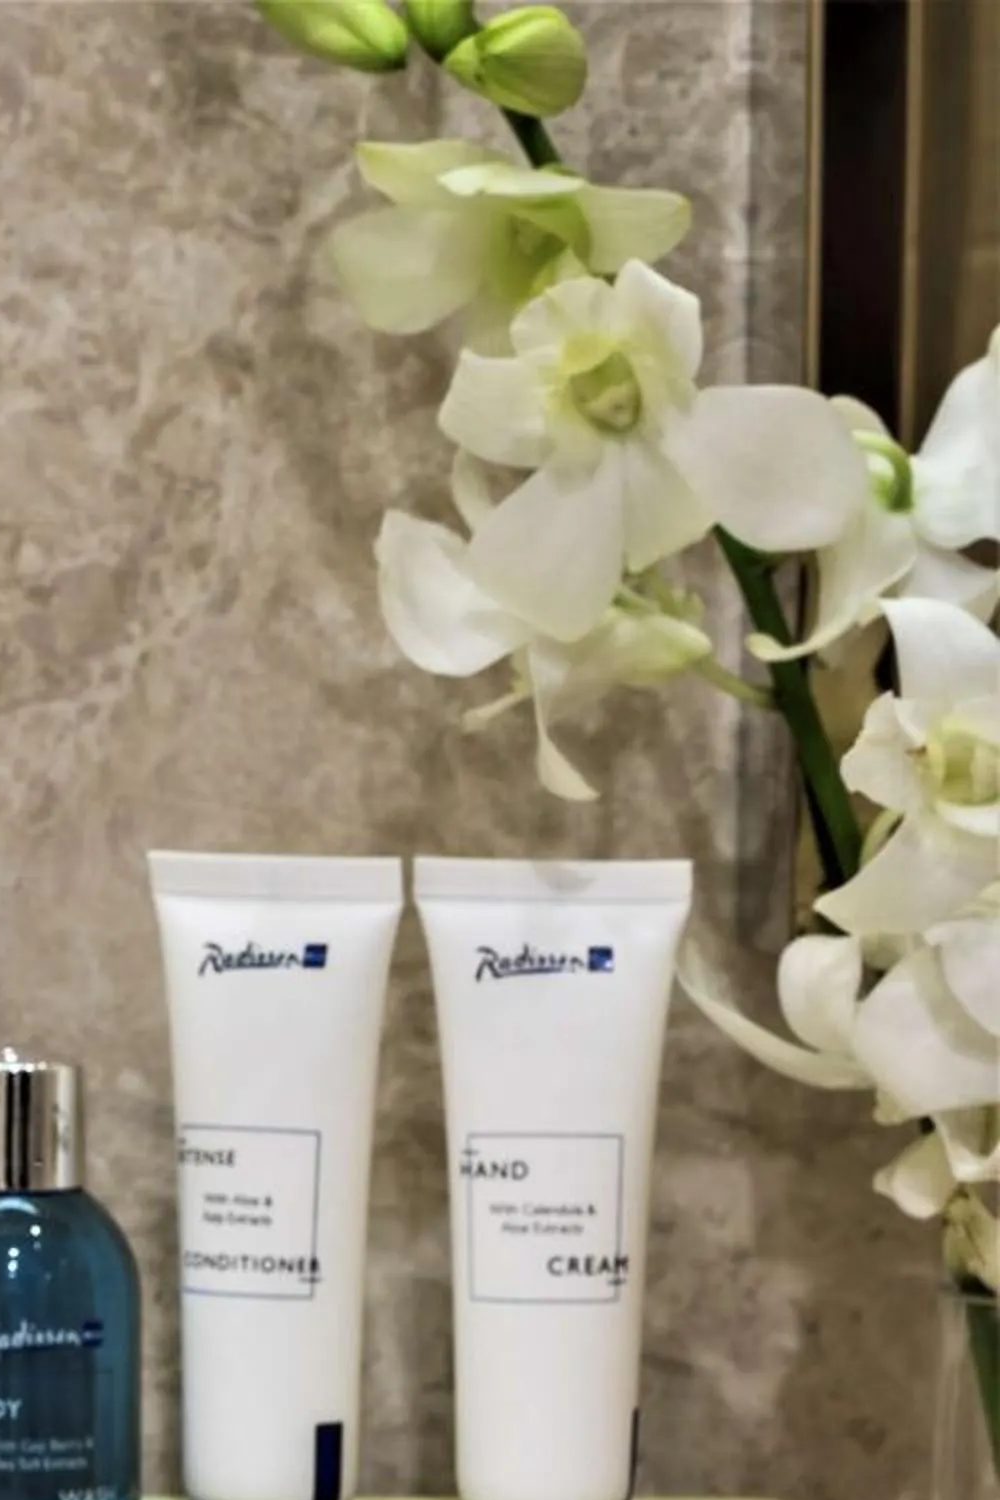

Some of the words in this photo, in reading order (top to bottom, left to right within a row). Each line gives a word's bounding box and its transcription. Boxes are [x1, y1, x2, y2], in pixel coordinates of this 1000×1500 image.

[198, 940, 301, 976] Radisson
[475, 943, 584, 982] Radisson
[460, 1160, 529, 1181] HAND
[547, 1256, 629, 1276] CREAM
